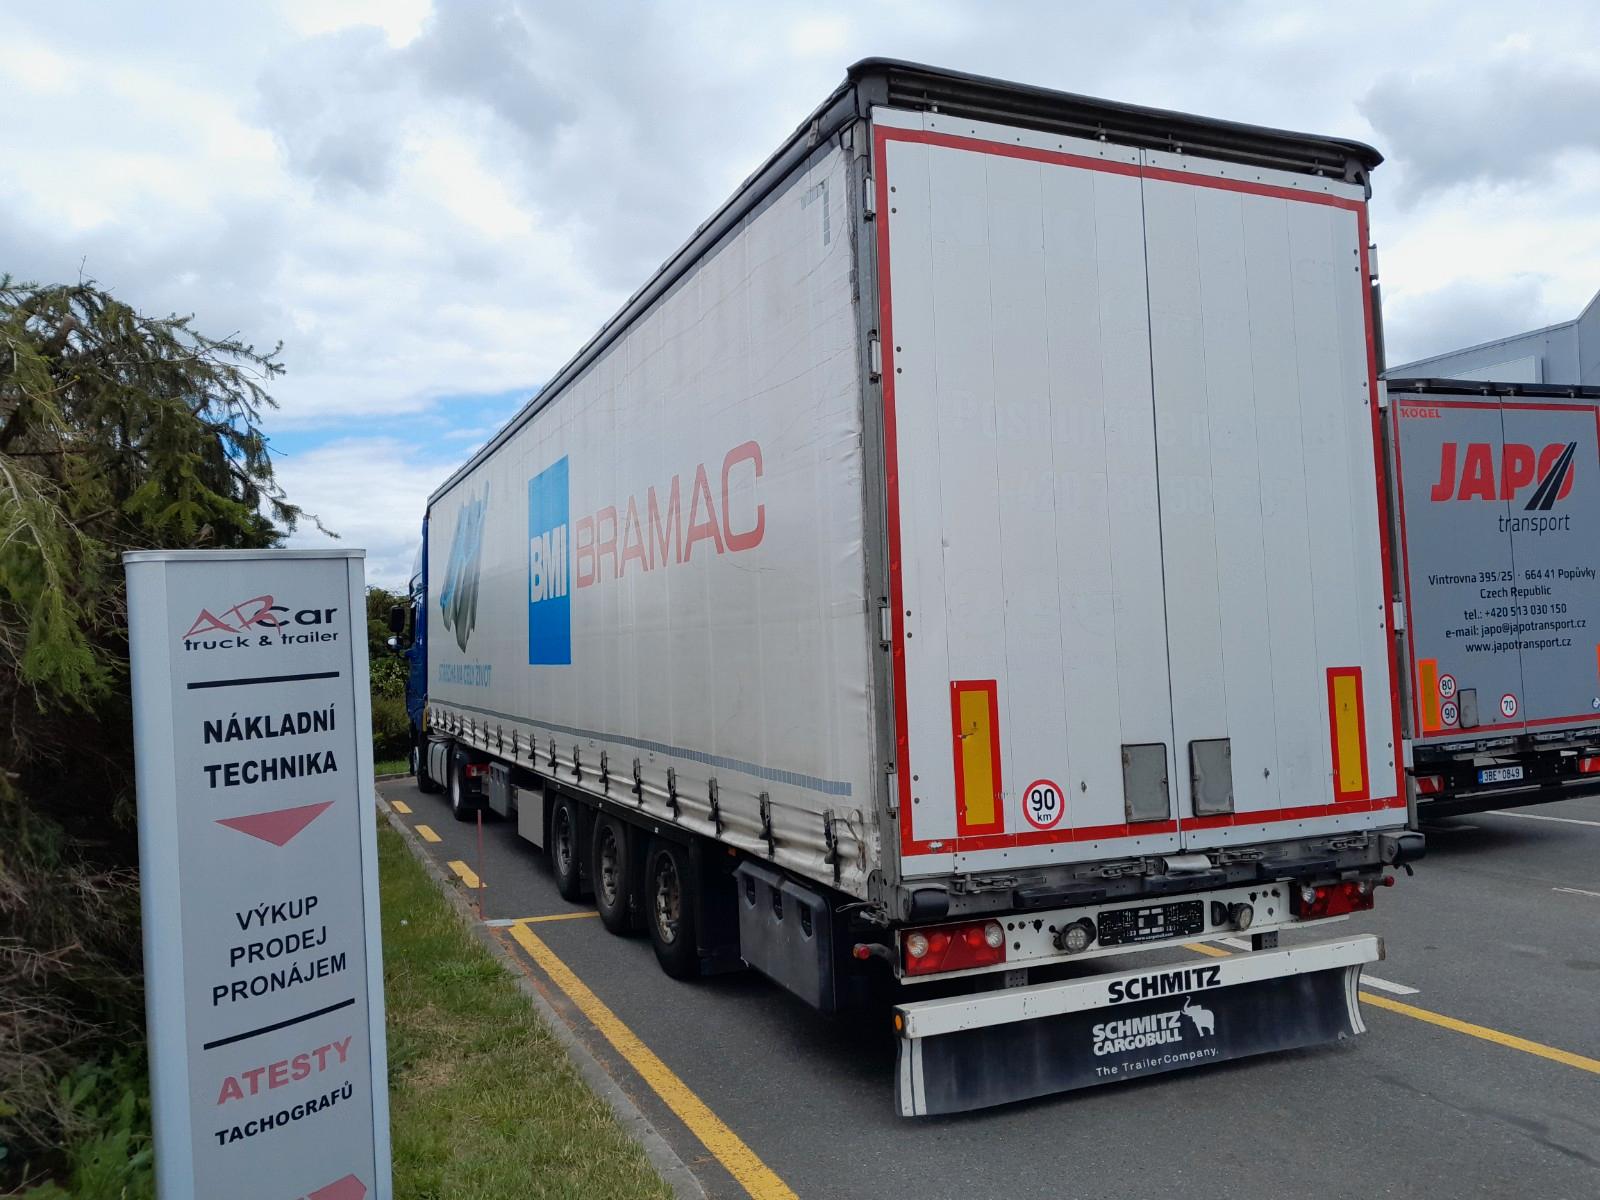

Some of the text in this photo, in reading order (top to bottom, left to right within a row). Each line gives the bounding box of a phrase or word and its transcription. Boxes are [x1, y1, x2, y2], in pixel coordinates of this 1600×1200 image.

[1431, 442, 1575, 502] JAPO
[576, 440, 765, 589] BRAMAC
[1499, 514, 1570, 536] transport
[530, 524, 567, 603] BMI
[1428, 566, 1596, 586] Vintrovna 395/25 664 41 Popůvky
[1480, 585, 1552, 599] Czech Republic
[1485, 607, 1508, 618] +420
[1510, 605, 1528, 617] 513
[1530, 604, 1548, 615] 030
[1550, 603, 1567, 614] 150
[1445, 619, 1586, 638] e-mail: japo@japotransport.cz
[184, 631, 339, 651] truck & trailer
[1465, 638, 1572, 653] www.japotransport.cz
[1442, 679, 1452, 691] 80
[1444, 707, 1455, 719] 90
[1503, 700, 1513, 711] 70
[203, 703, 335, 744] NÁKLADNÍ
[203, 750, 338, 789] TECHNIKA
[1484, 767, 1520, 781] 3BE 0849
[1031, 789, 1055, 812] 90
[1037, 812, 1052, 822] km
[236, 896, 318, 931] VÝKUP
[230, 926, 327, 967] PRODEJ
[213, 952, 347, 1006] PRONÁJEM
[1108, 965, 1221, 1004] SCHMITZ
[1092, 1010, 1182, 1042] SCHMITZ
[1093, 1027, 1183, 1056] CARGOBULL
[217, 1036, 352, 1105] ATESTY
[1096, 1066, 1118, 1077] The
[215, 1080, 353, 1146] TACHOGRAFŮ
